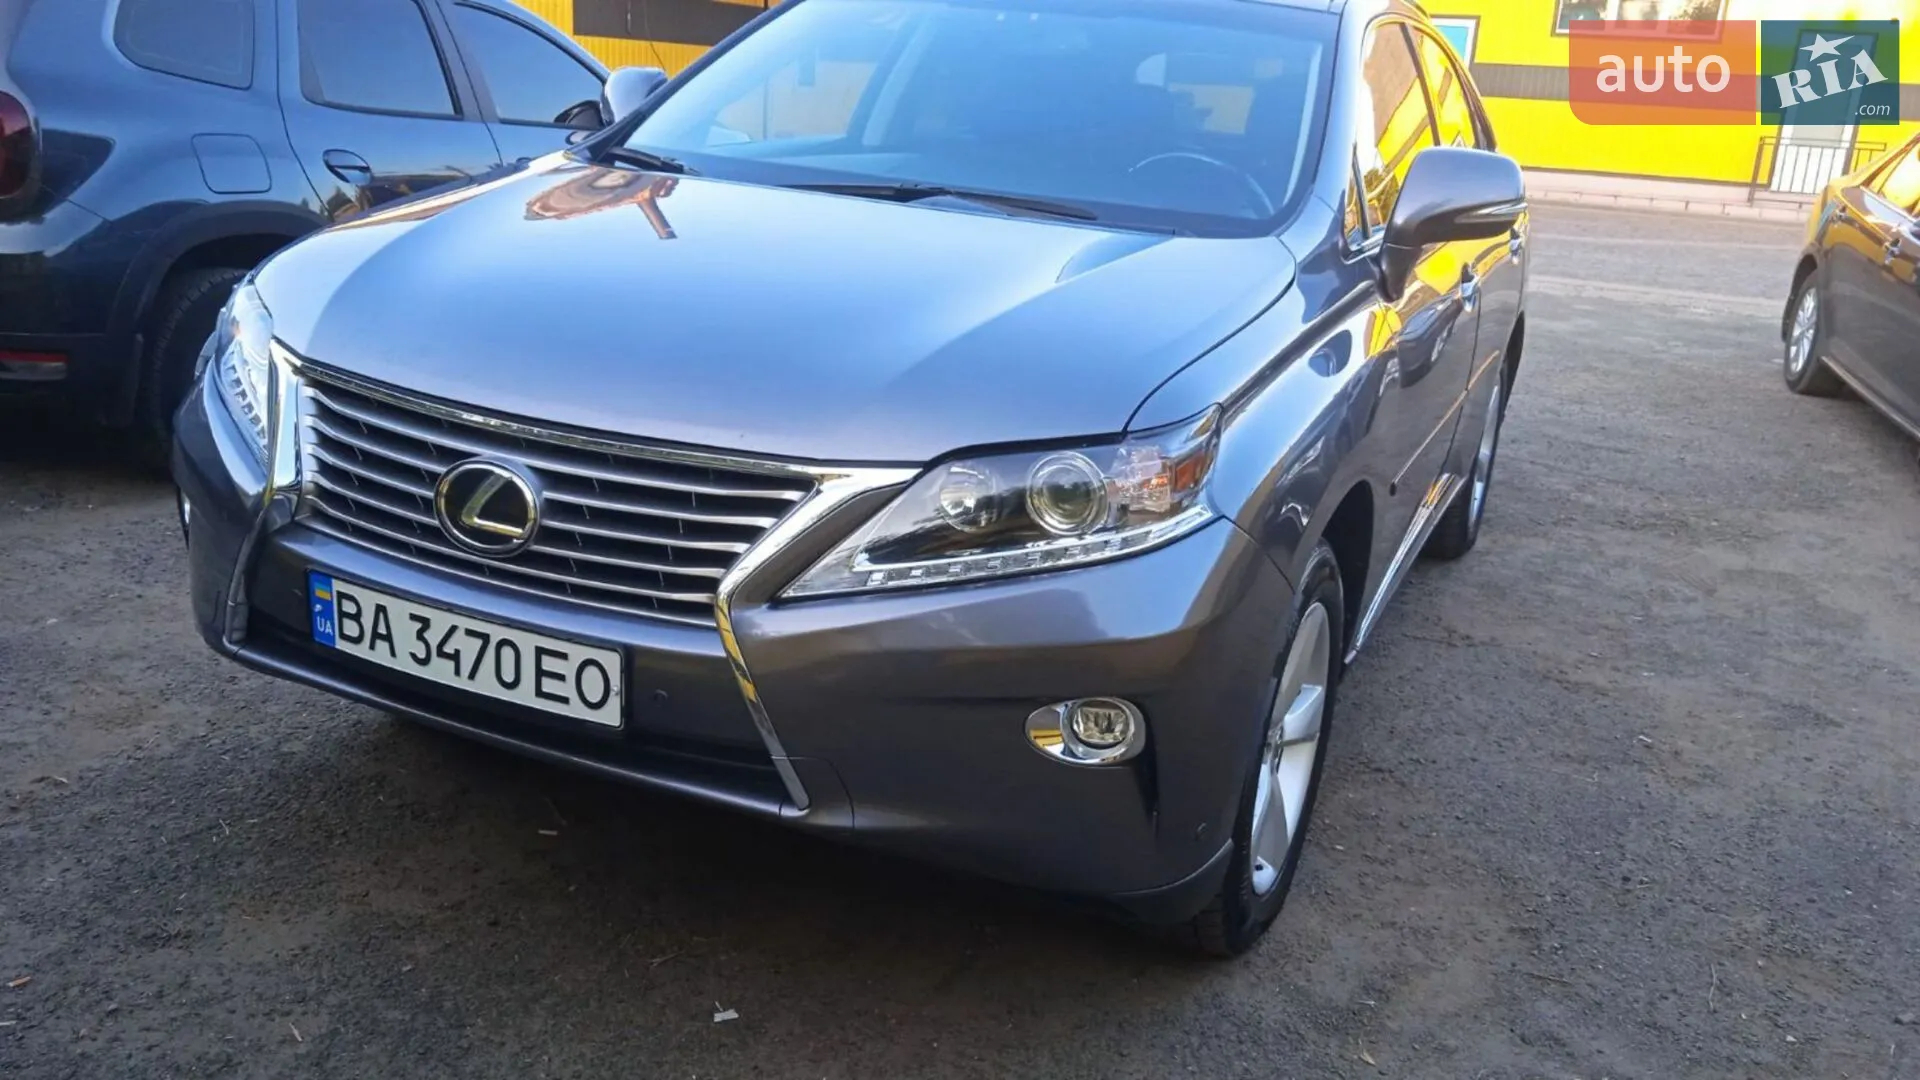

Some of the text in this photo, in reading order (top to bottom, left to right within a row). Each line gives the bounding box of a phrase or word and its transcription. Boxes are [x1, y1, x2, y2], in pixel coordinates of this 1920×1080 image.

[316, 615, 334, 637] UA
[336, 590, 612, 711] BA 3470 EO
